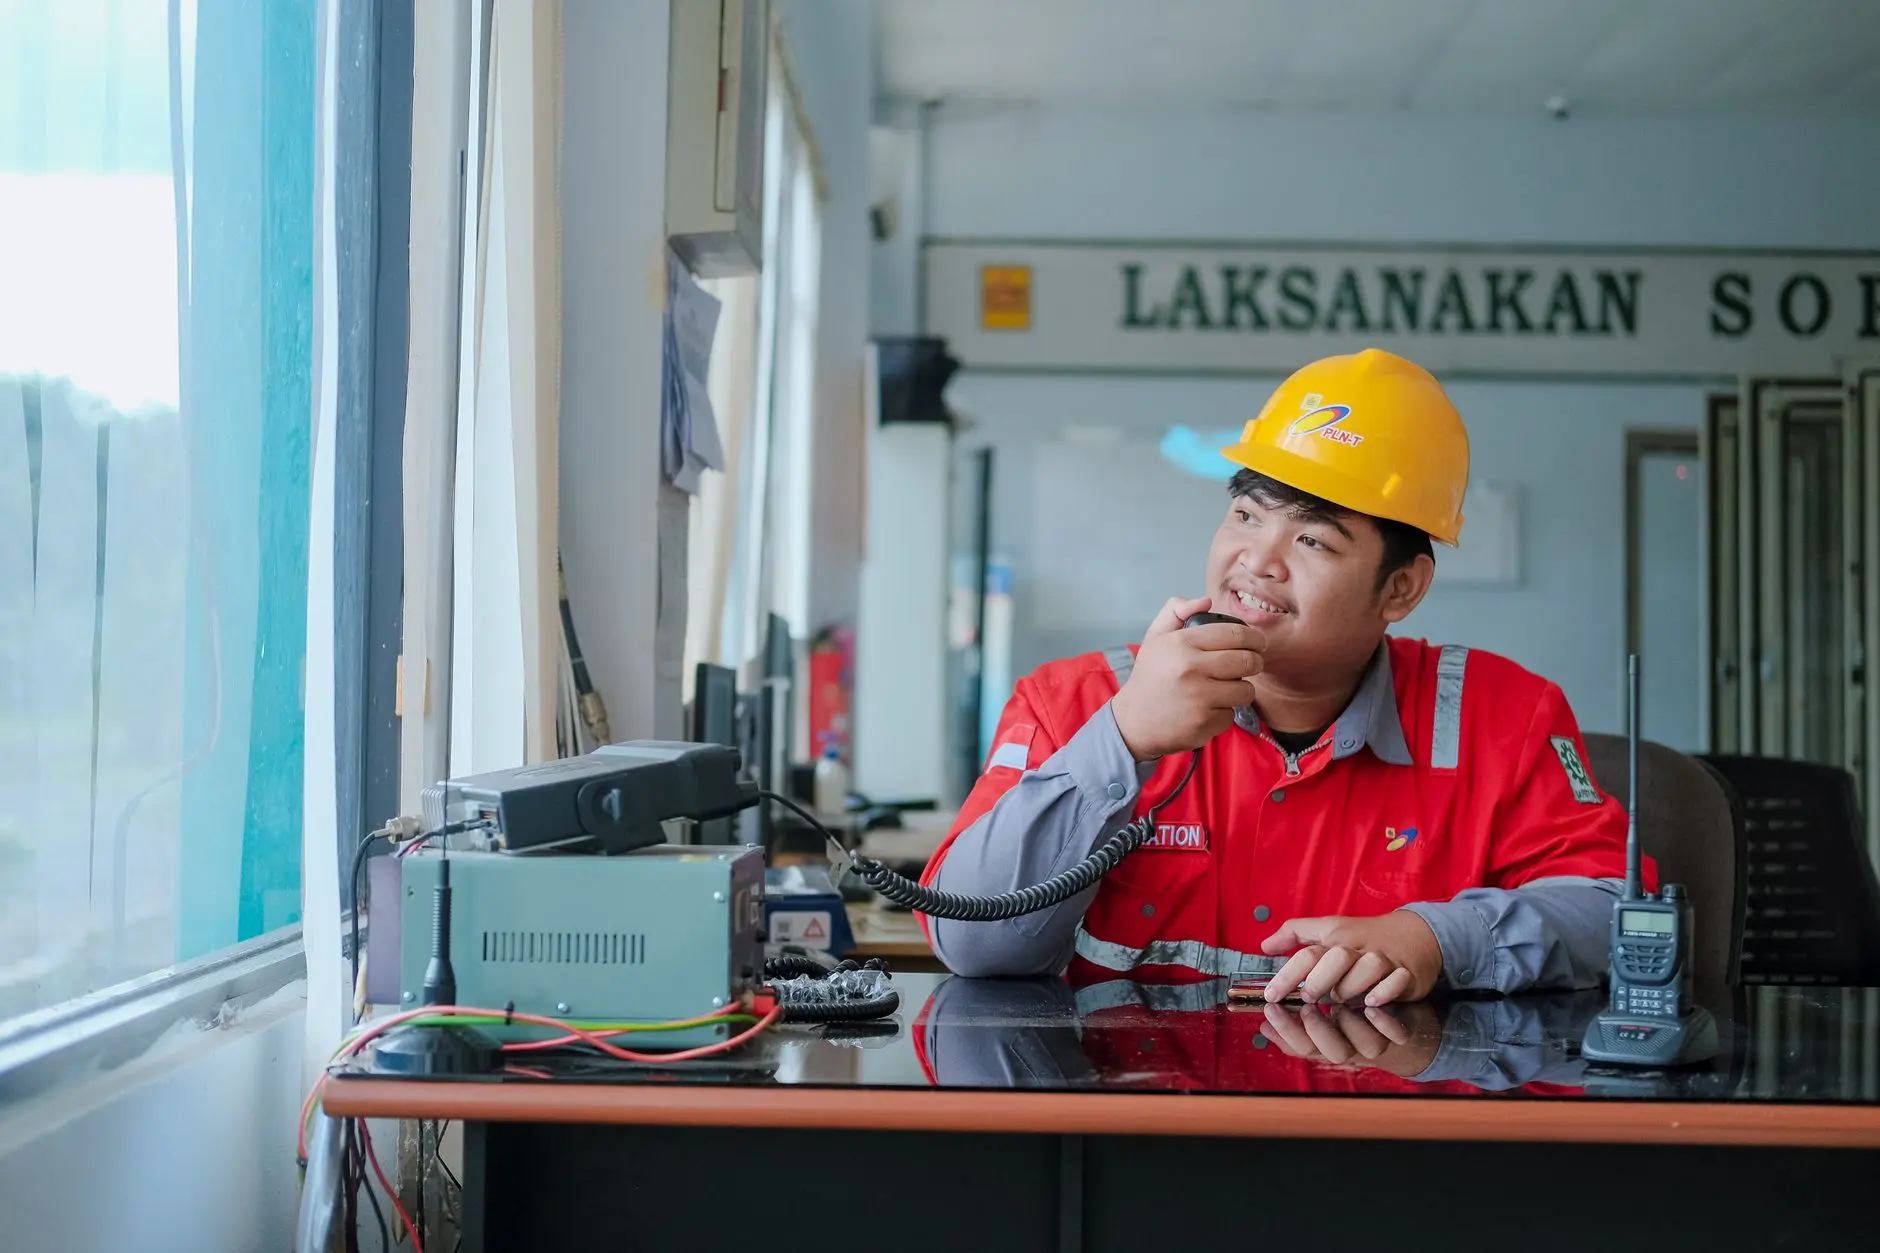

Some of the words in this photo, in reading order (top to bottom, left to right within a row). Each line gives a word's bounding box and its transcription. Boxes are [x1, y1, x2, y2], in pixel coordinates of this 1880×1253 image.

[1120, 262, 1642, 335] LAKSANAKAN
[1322, 427, 1363, 447] PLN-T
[1141, 825, 1200, 847] ATION
